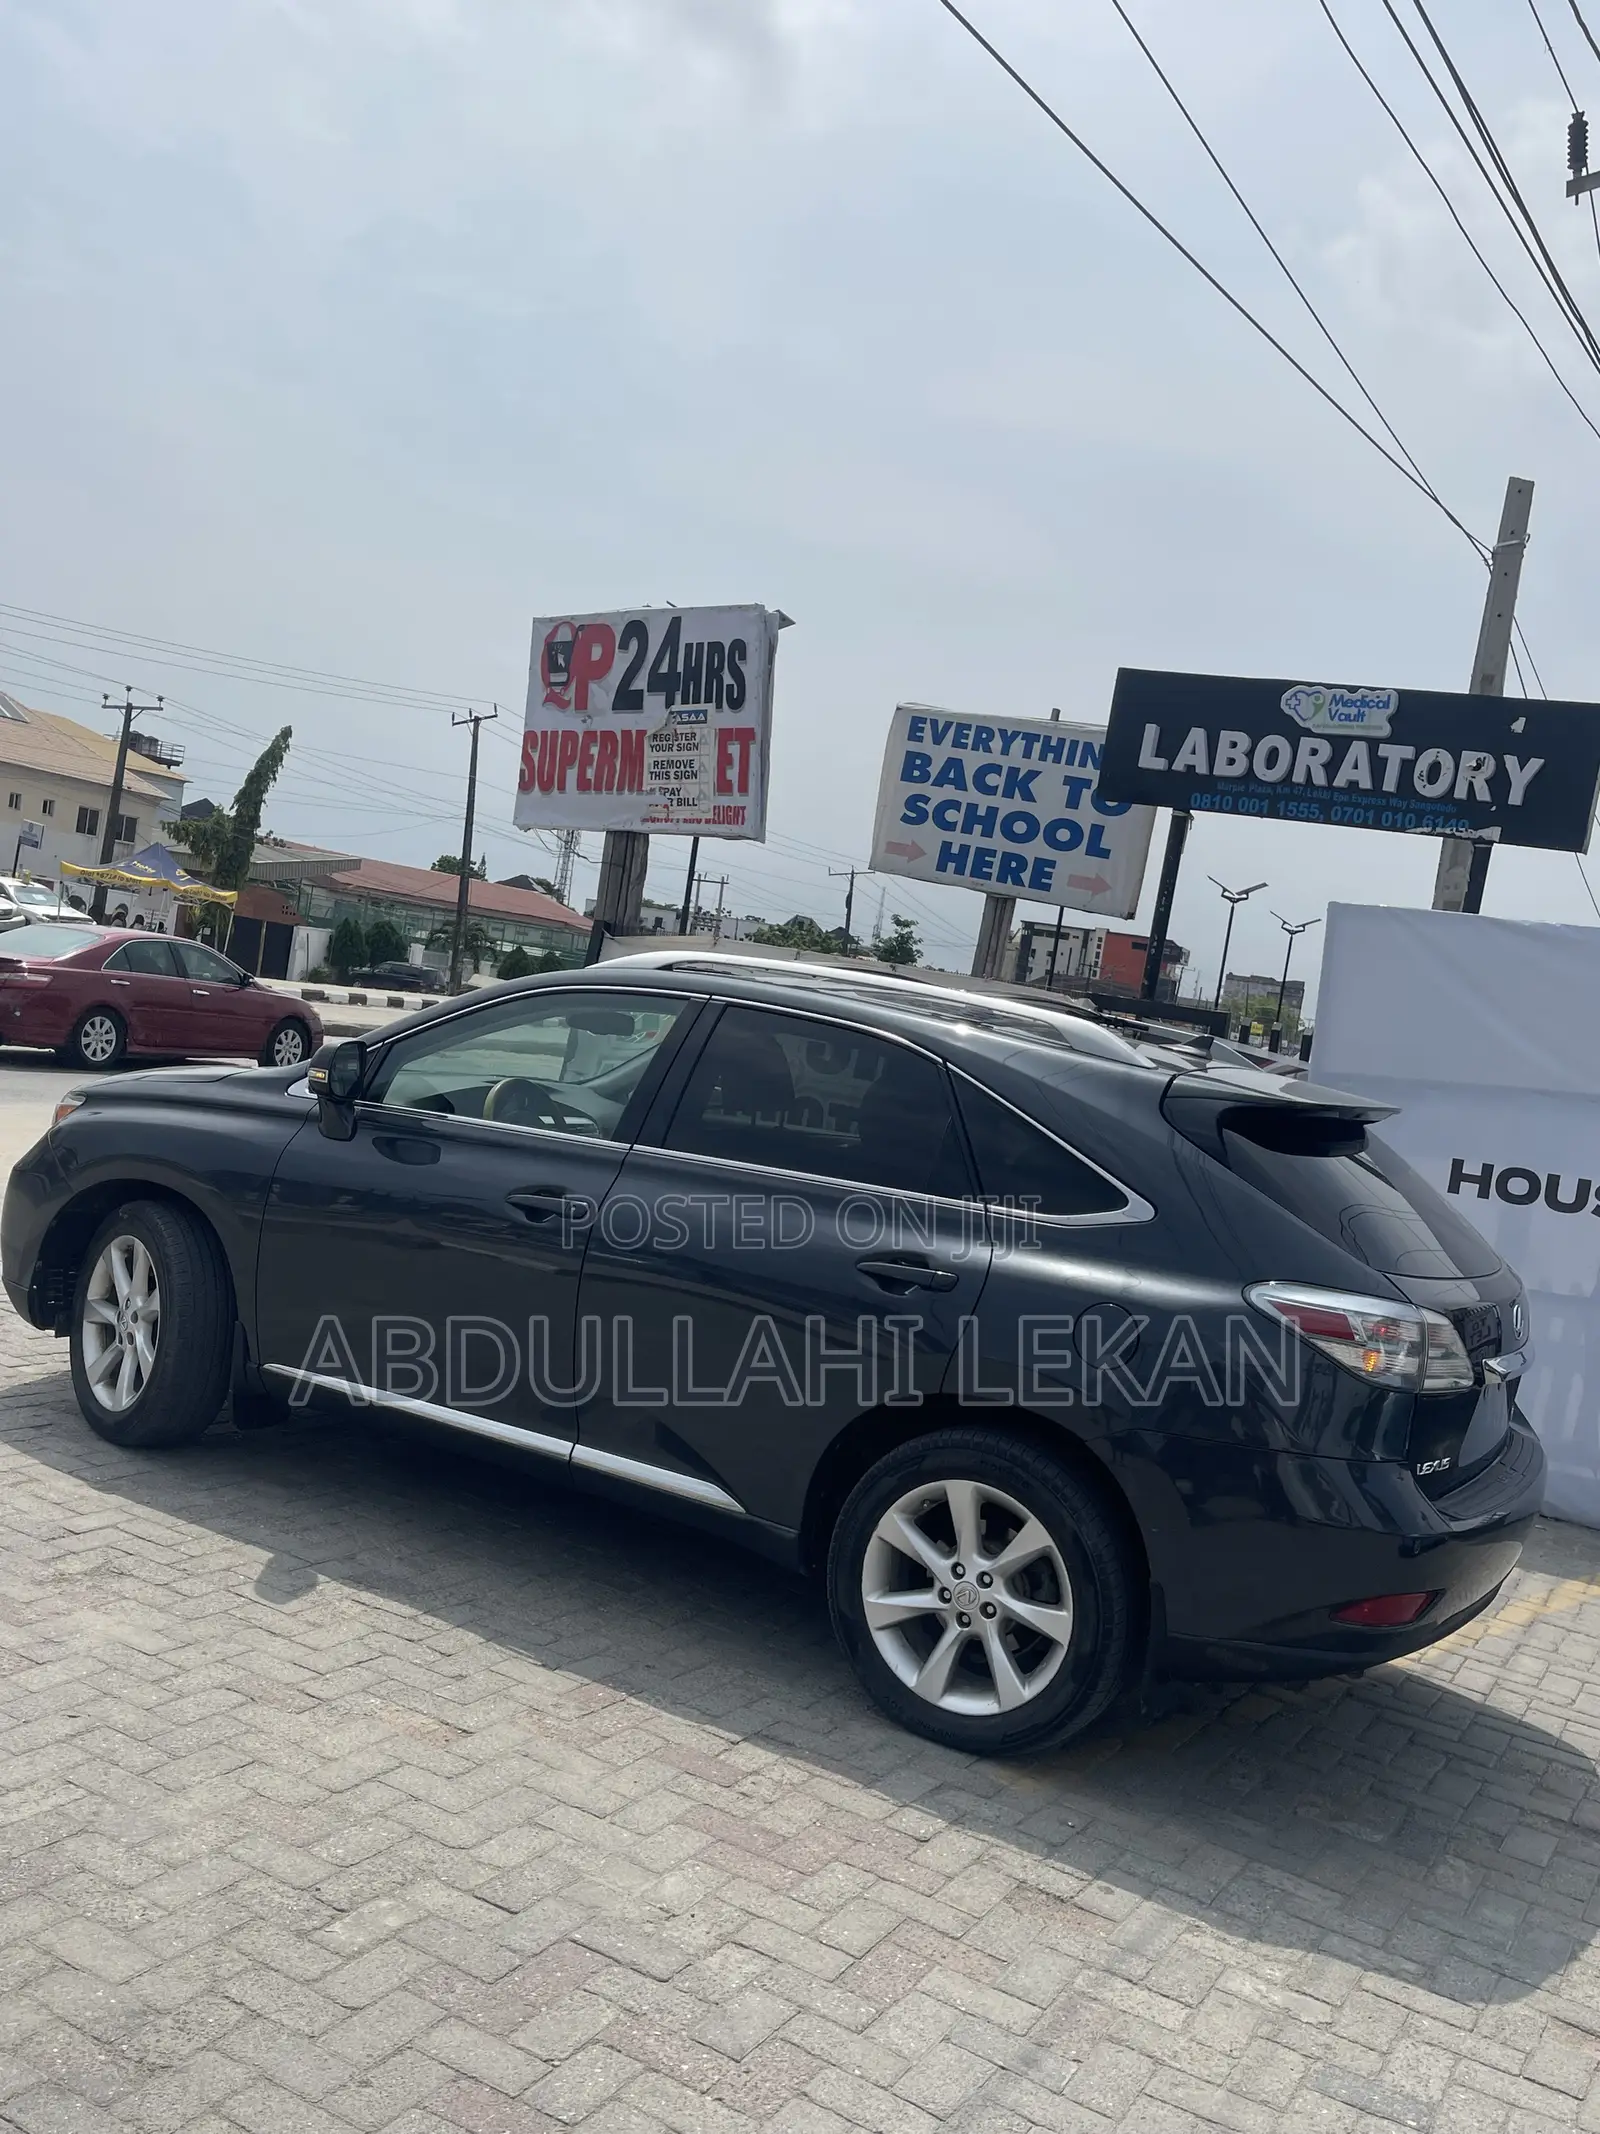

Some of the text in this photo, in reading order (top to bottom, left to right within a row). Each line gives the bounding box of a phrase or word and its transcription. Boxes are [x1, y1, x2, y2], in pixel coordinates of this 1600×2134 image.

[1328, 693, 1391, 710] Medical
[673, 711, 706, 722] ASAA
[1328, 708, 1366, 722] Vault
[649, 742, 699, 753] YOUR SIGN
[907, 716, 1104, 770] EVERYTHIN
[518, 727, 756, 795] SUPERMET
[653, 759, 695, 770] REMOVE
[1137, 723, 1545, 806] LABORATORY
[649, 770, 698, 781] THIS SIGN
[900, 750, 1043, 803] BACK
[663, 787, 682, 797] PAY
[677, 798, 698, 807] BILL
[1190, 793, 1233, 810] 0810
[1238, 797, 1269, 814] 001
[1277, 800, 1324, 821] 1555,
[1330, 806, 1375, 824] 0701
[1381, 811, 1416, 828] 010
[1351, 793, 1386, 806] Express
[1389, 797, 1408, 810] Way
[704, 805, 747, 825] ELIGHT
[900, 793, 1113, 859] SCHOOL
[935, 840, 1057, 892] HERE
[1447, 1158, 1600, 1218] HOU
[1416, 1457, 1451, 1475] LEXUS
